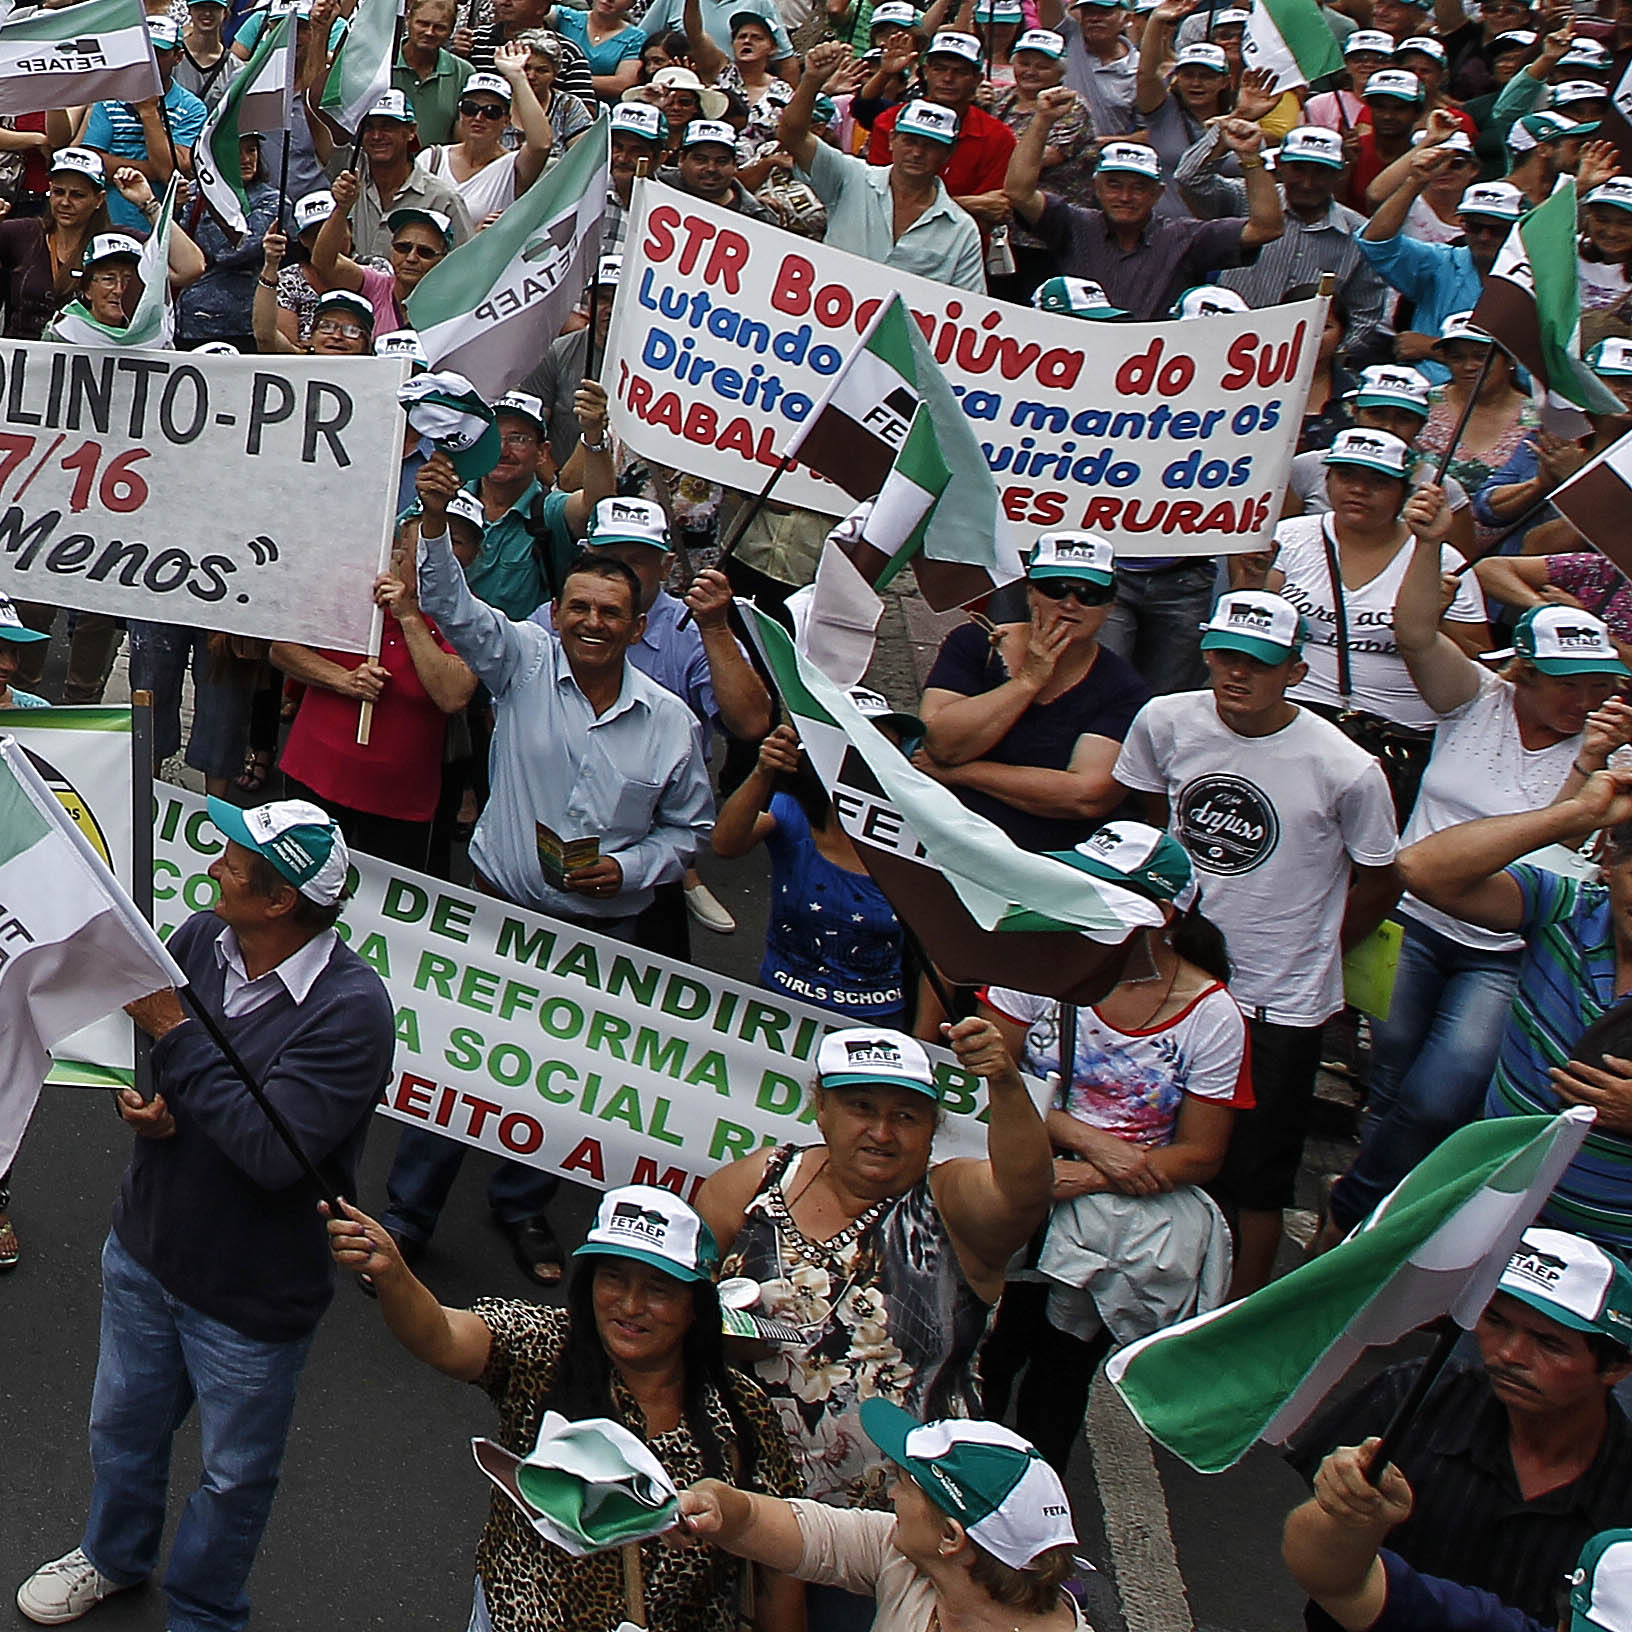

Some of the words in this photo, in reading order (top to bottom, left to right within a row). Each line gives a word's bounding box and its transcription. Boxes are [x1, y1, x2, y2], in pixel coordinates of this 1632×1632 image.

[643, 205, 750, 295] STR
[1116, 337, 1195, 397] do
[1221, 319, 1308, 391] Sul
[639, 267, 843, 375] Lutando
[1011, 400, 1225, 440] manter
[1232, 400, 1282, 435] os
[1162, 450, 1253, 490] dos
[382, 877, 478, 945] DE
[773, 970, 828, 1002] GIRLS
[414, 949, 731, 1097] REFORMA
[848, 1050, 902, 1064] FETAEP
[443, 1025, 686, 1148] SOCIAL
[561, 1135, 607, 1184] A
[611, 1216, 666, 1240] FETAEP
[1507, 1255, 1559, 1282] ETAEP
